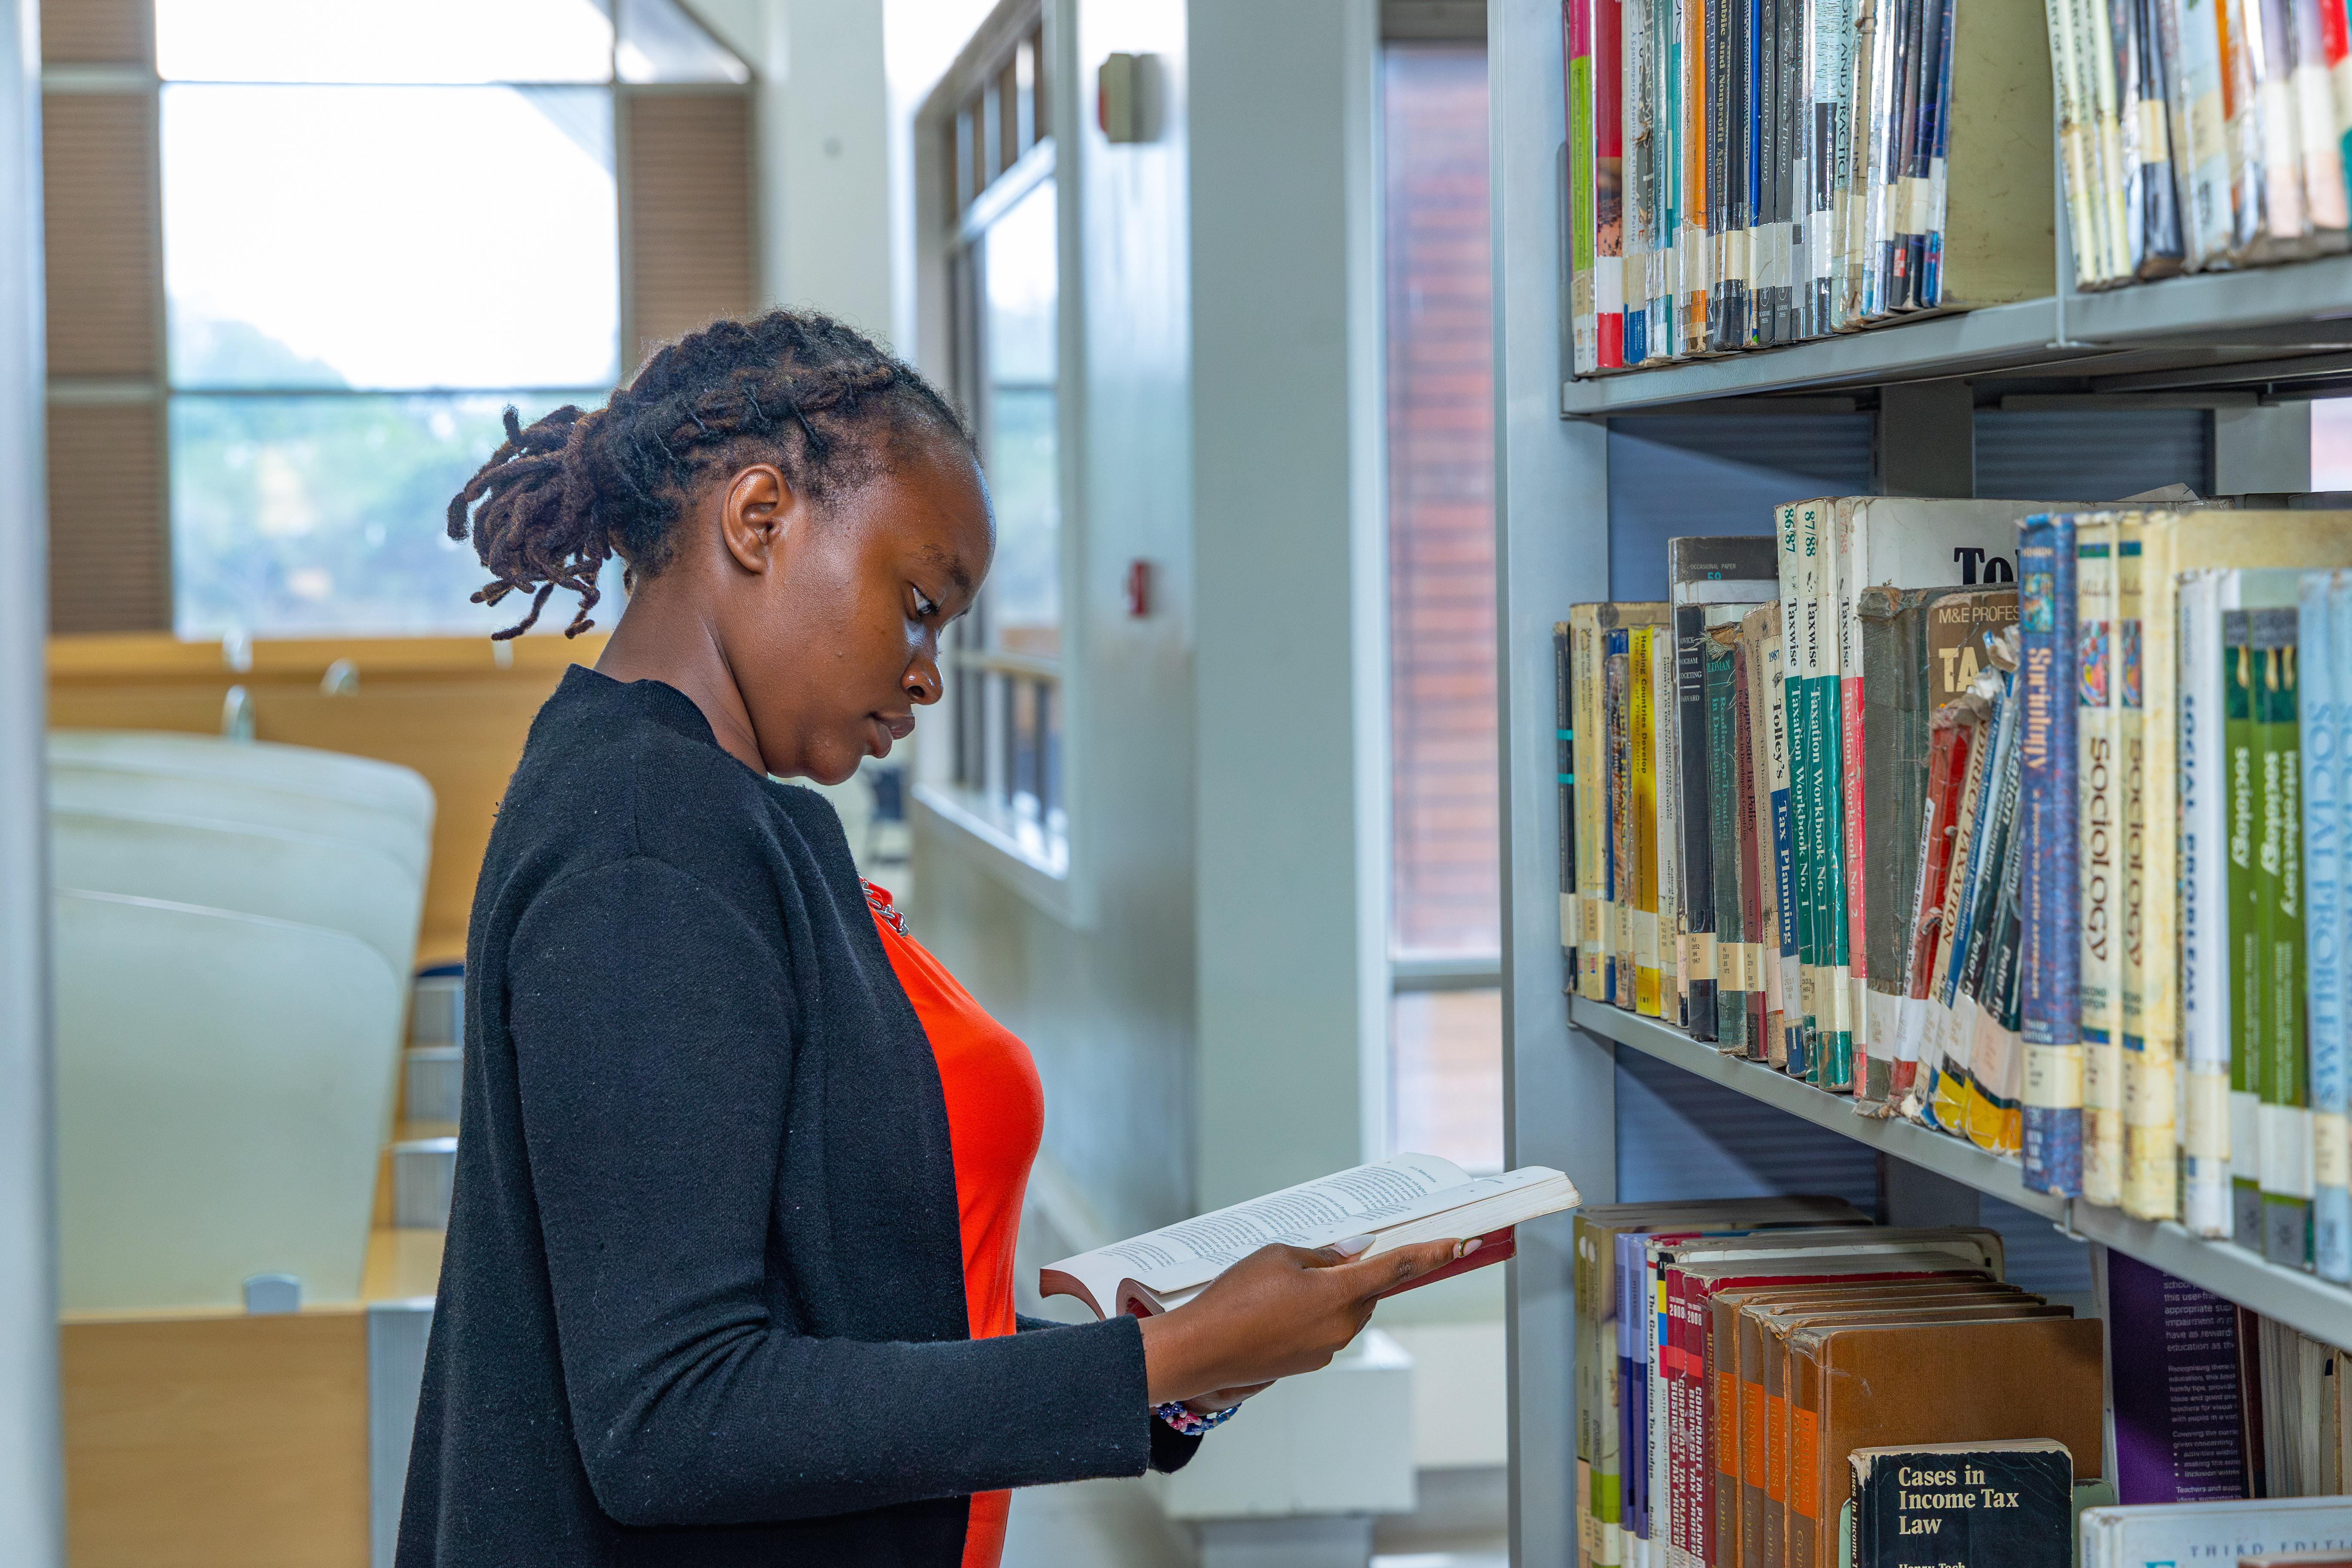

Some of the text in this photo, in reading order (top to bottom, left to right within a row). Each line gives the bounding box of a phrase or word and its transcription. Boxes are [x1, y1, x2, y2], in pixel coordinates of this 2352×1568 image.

[1717, 74, 1725, 143] Nonprofit
[1838, 94, 1847, 185] PRACTICE
[1780, 127, 1788, 177] Theory
[1784, 508, 1796, 553] 86/87
[1804, 511, 1816, 557] 87/88
[1788, 598, 1799, 668] Taxwise
[1807, 598, 1819, 668] Taxwise
[1841, 597, 1850, 668] Taxwise
[1939, 607, 1970, 623] M&E
[1706, 660, 1730, 673] LDMAN
[1769, 649, 1779, 662] 1987
[1712, 697, 1719, 712] in
[1791, 686, 1803, 761] Taxation
[1810, 686, 1822, 763] Taxation
[1844, 687, 1853, 766] Taxation
[2022, 647, 2053, 772] Sociology
[1747, 795, 1756, 833] Policy
[1772, 698, 1792, 945] Tolley's Tax Planning
[1796, 766, 1807, 857] Workbook
[1813, 769, 1825, 861] Workbook
[1846, 771, 1857, 864] Workbook
[2230, 747, 2254, 870] sociology
[2260, 751, 2282, 877] sociology
[1800, 862, 1808, 892] No.
[1816, 865, 1826, 897] No.
[2086, 737, 2110, 961] SOCIOLOGY
[1850, 908, 1858, 919] 2
[1942, 828, 1973, 946] TAXATION
[2309, 705, 2340, 1102] SOCIAL PROBLEMS
[1669, 1303, 1685, 1319] 2008
[1687, 1310, 1702, 1326] 2008
[1670, 1381, 1679, 1453] BUSINESS
[1721, 1379, 1730, 1461] BUSINESS
[1749, 1389, 1757, 1473] BUSINESS
[1770, 1403, 1779, 1487] BUSINESS
[1801, 1417, 1810, 1502] BUSINESS
[1899, 1464, 1986, 1487] Cases in
[1851, 1500, 1858, 1513] in
[1899, 1488, 2019, 1510] Income Tax
[1899, 1516, 1942, 1535] Law
[2190, 1544, 2264, 1558] THIRD
